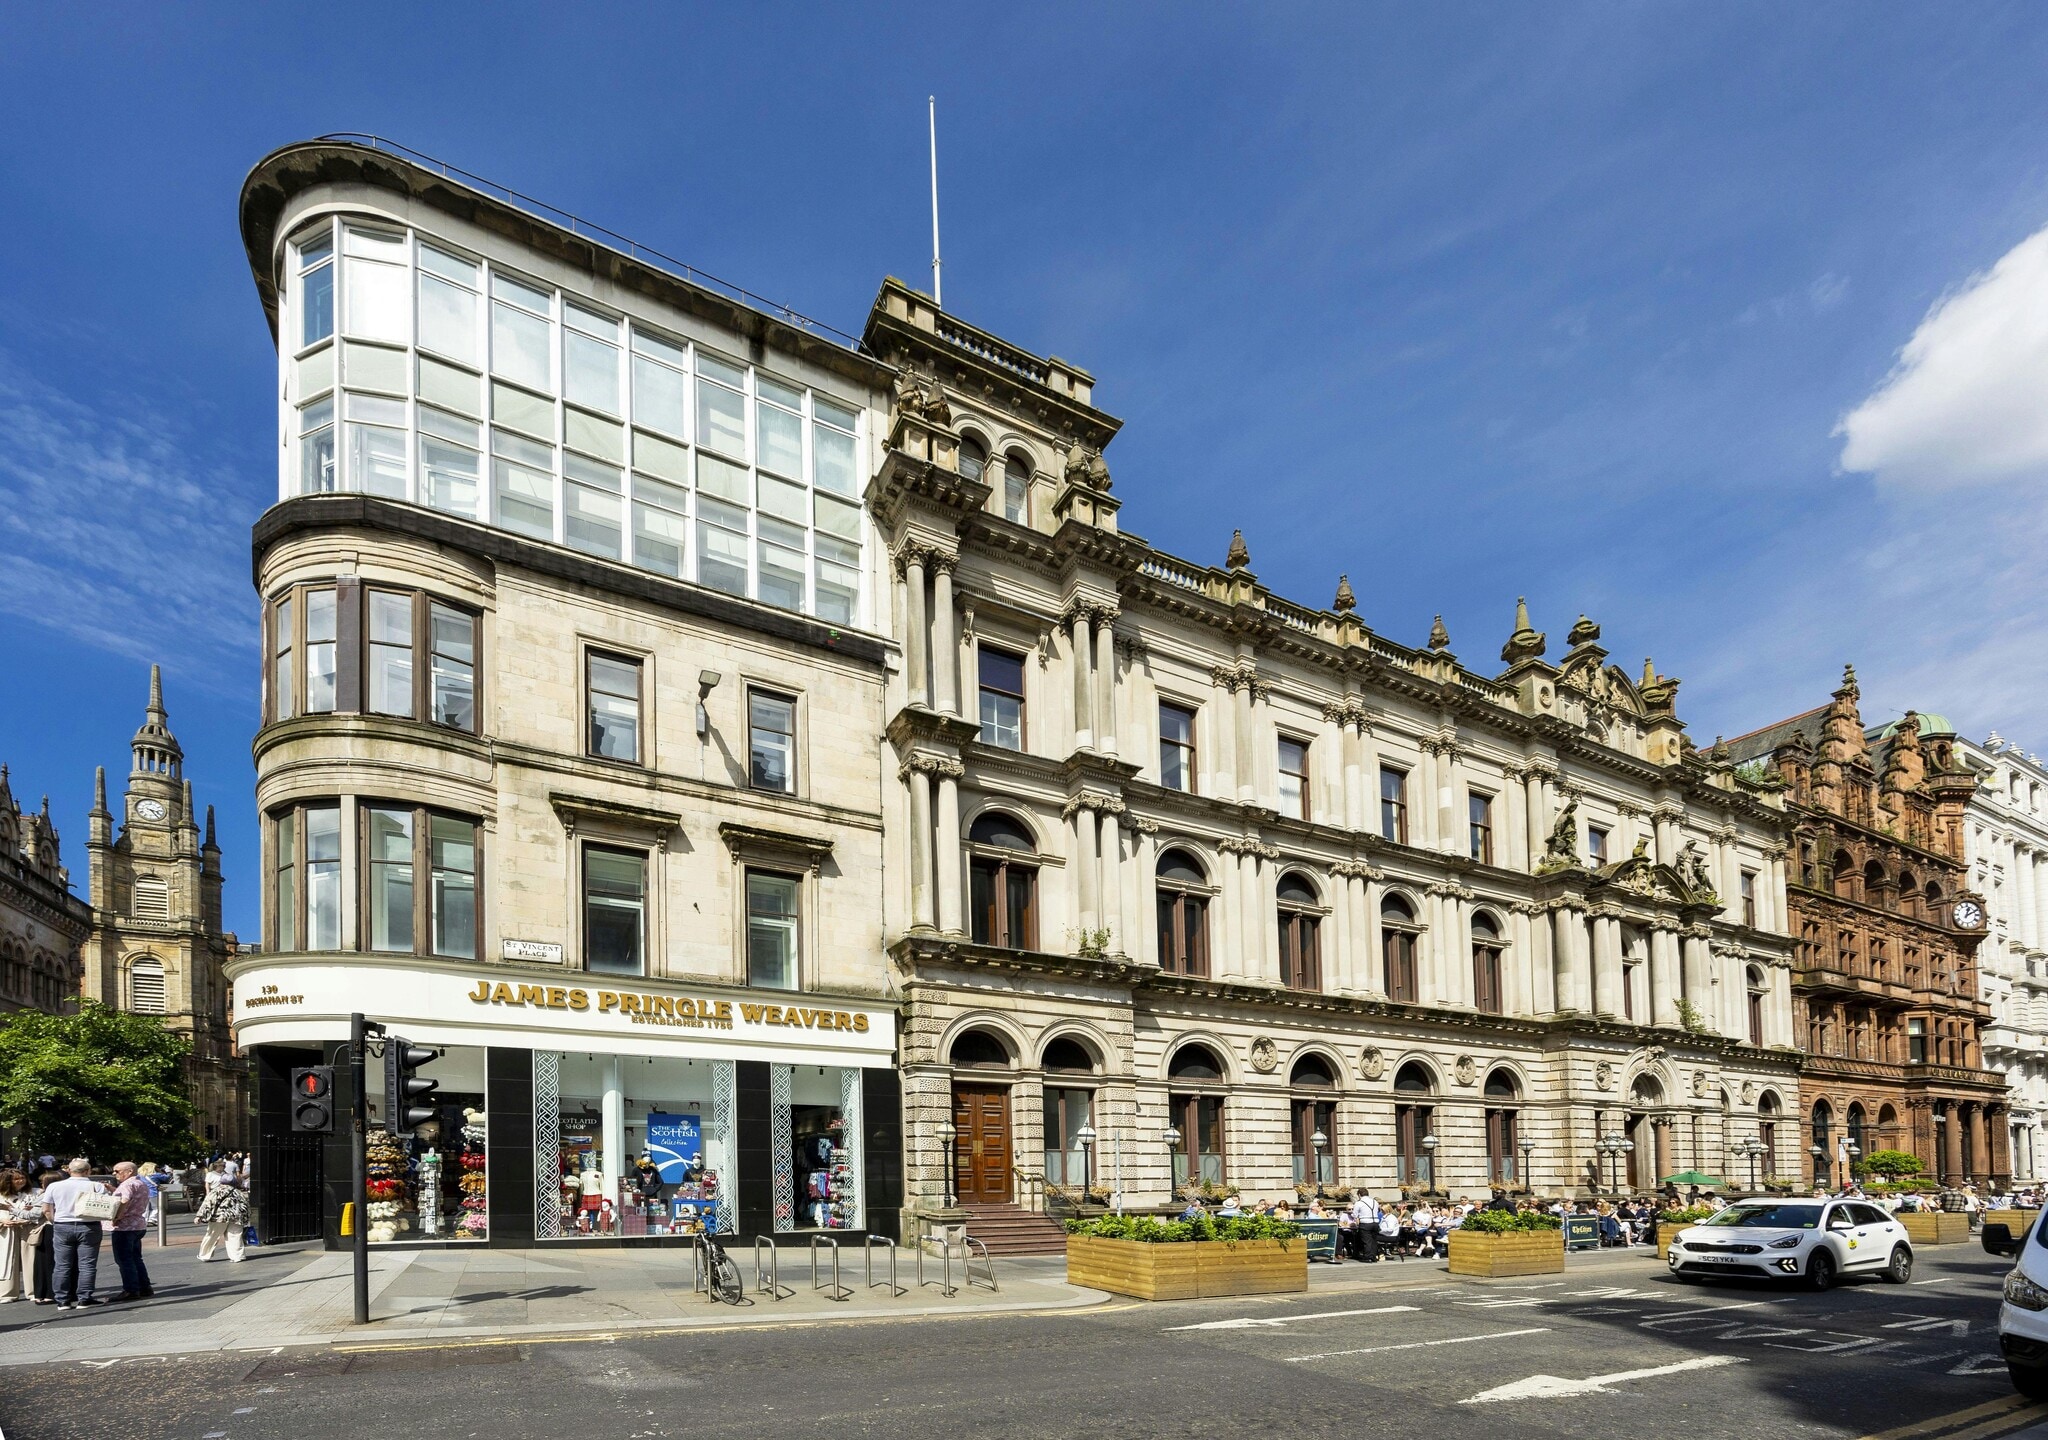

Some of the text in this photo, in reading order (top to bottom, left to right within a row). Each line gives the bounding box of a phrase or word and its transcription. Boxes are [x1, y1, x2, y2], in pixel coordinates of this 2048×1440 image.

[522, 943, 559, 952] VINCENT
[518, 949, 547, 957] PLACE
[262, 985, 278, 995] 130
[290, 995, 304, 1004] ST
[468, 981, 869, 1031] JAMES PRINGLE WEAVERS
[632, 1016, 704, 1028] ESTABLISHED
[651, 1127, 697, 1137] Scottish
[1308, 1232, 1328, 1241] Citizen
